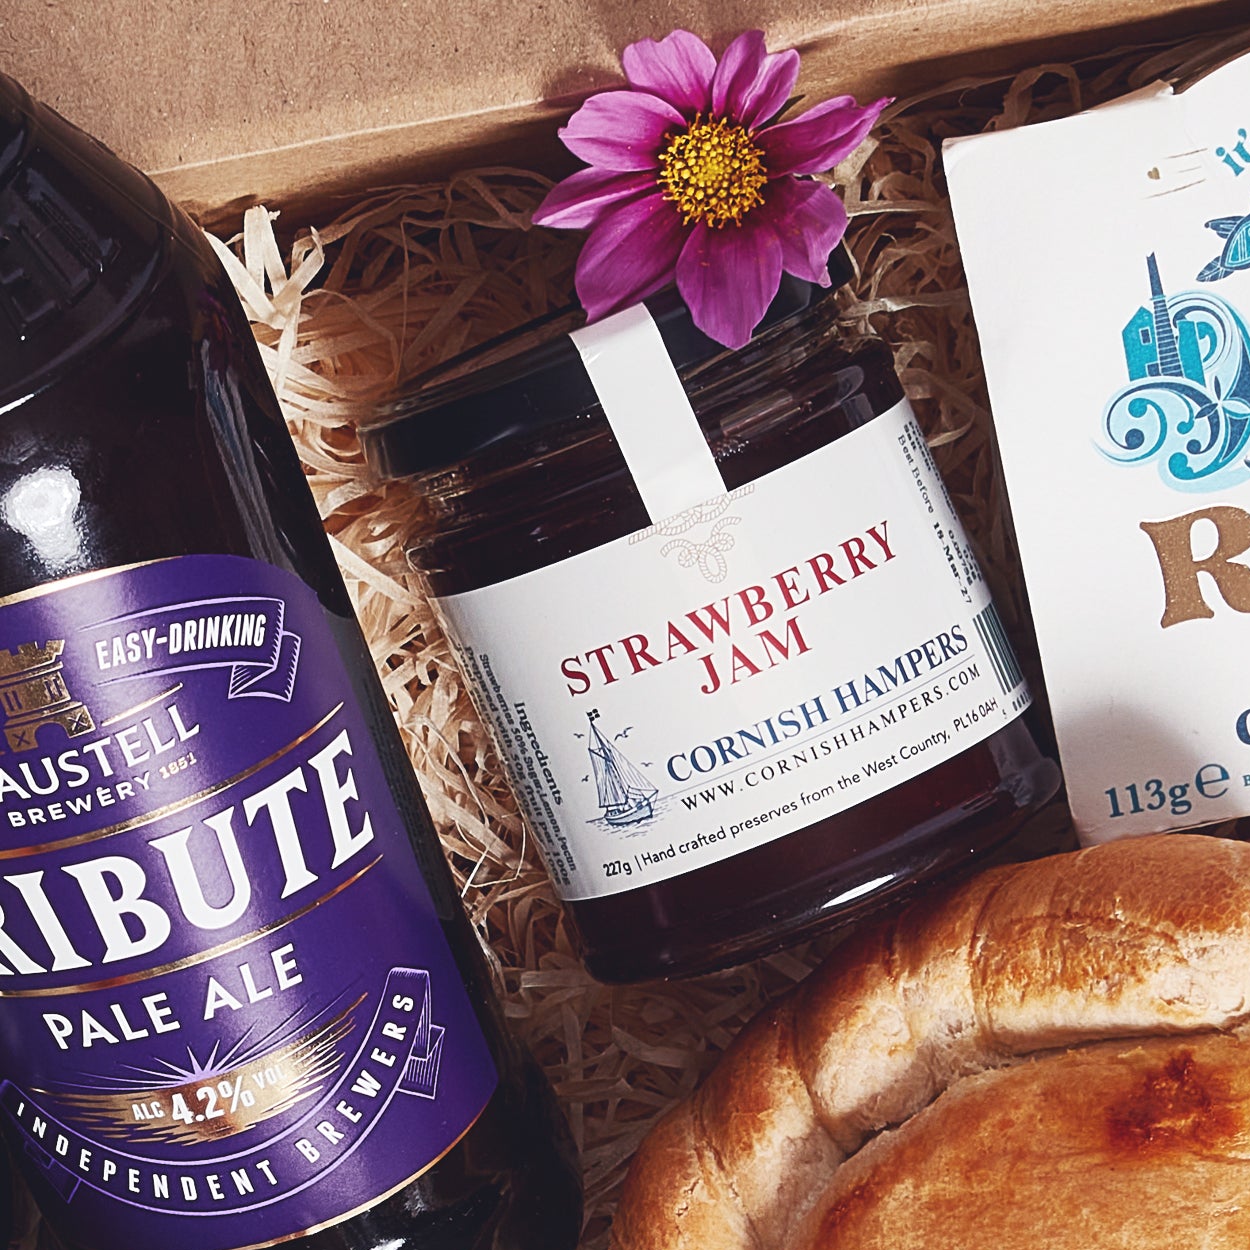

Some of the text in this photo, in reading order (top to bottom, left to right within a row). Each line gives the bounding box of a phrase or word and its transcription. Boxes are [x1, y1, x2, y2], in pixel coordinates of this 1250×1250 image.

[96, 612, 267, 670] EASY-DRINKING
[560, 521, 898, 697] STRAWBERRY
[700, 615, 812, 695] JAM
[495, 714, 513, 750] with
[513, 701, 563, 806] Ingredients
[667, 624, 968, 783] CORNISH HAMPERS
[681, 663, 980, 810] WWW.CORNISHHAMPERS.COM
[8, 751, 198, 828] BREWERY 1851
[603, 859, 632, 877] 227g
[640, 845, 676, 866] Hand
[679, 826, 727, 853] crafted
[730, 801, 798, 838] preserves
[800, 783, 836, 805] from
[838, 771, 861, 791] the
[862, 754, 899, 778] West
[900, 729, 951, 761] Country,
[954, 711, 980, 733] PL16
[1105, 777, 1190, 818] 113g
[43, 943, 303, 1050] PALE ALE
[16, 992, 415, 1201] INDEPENDENT BREWERS
[132, 1064, 288, 1125] ALC 4.2% VOL
